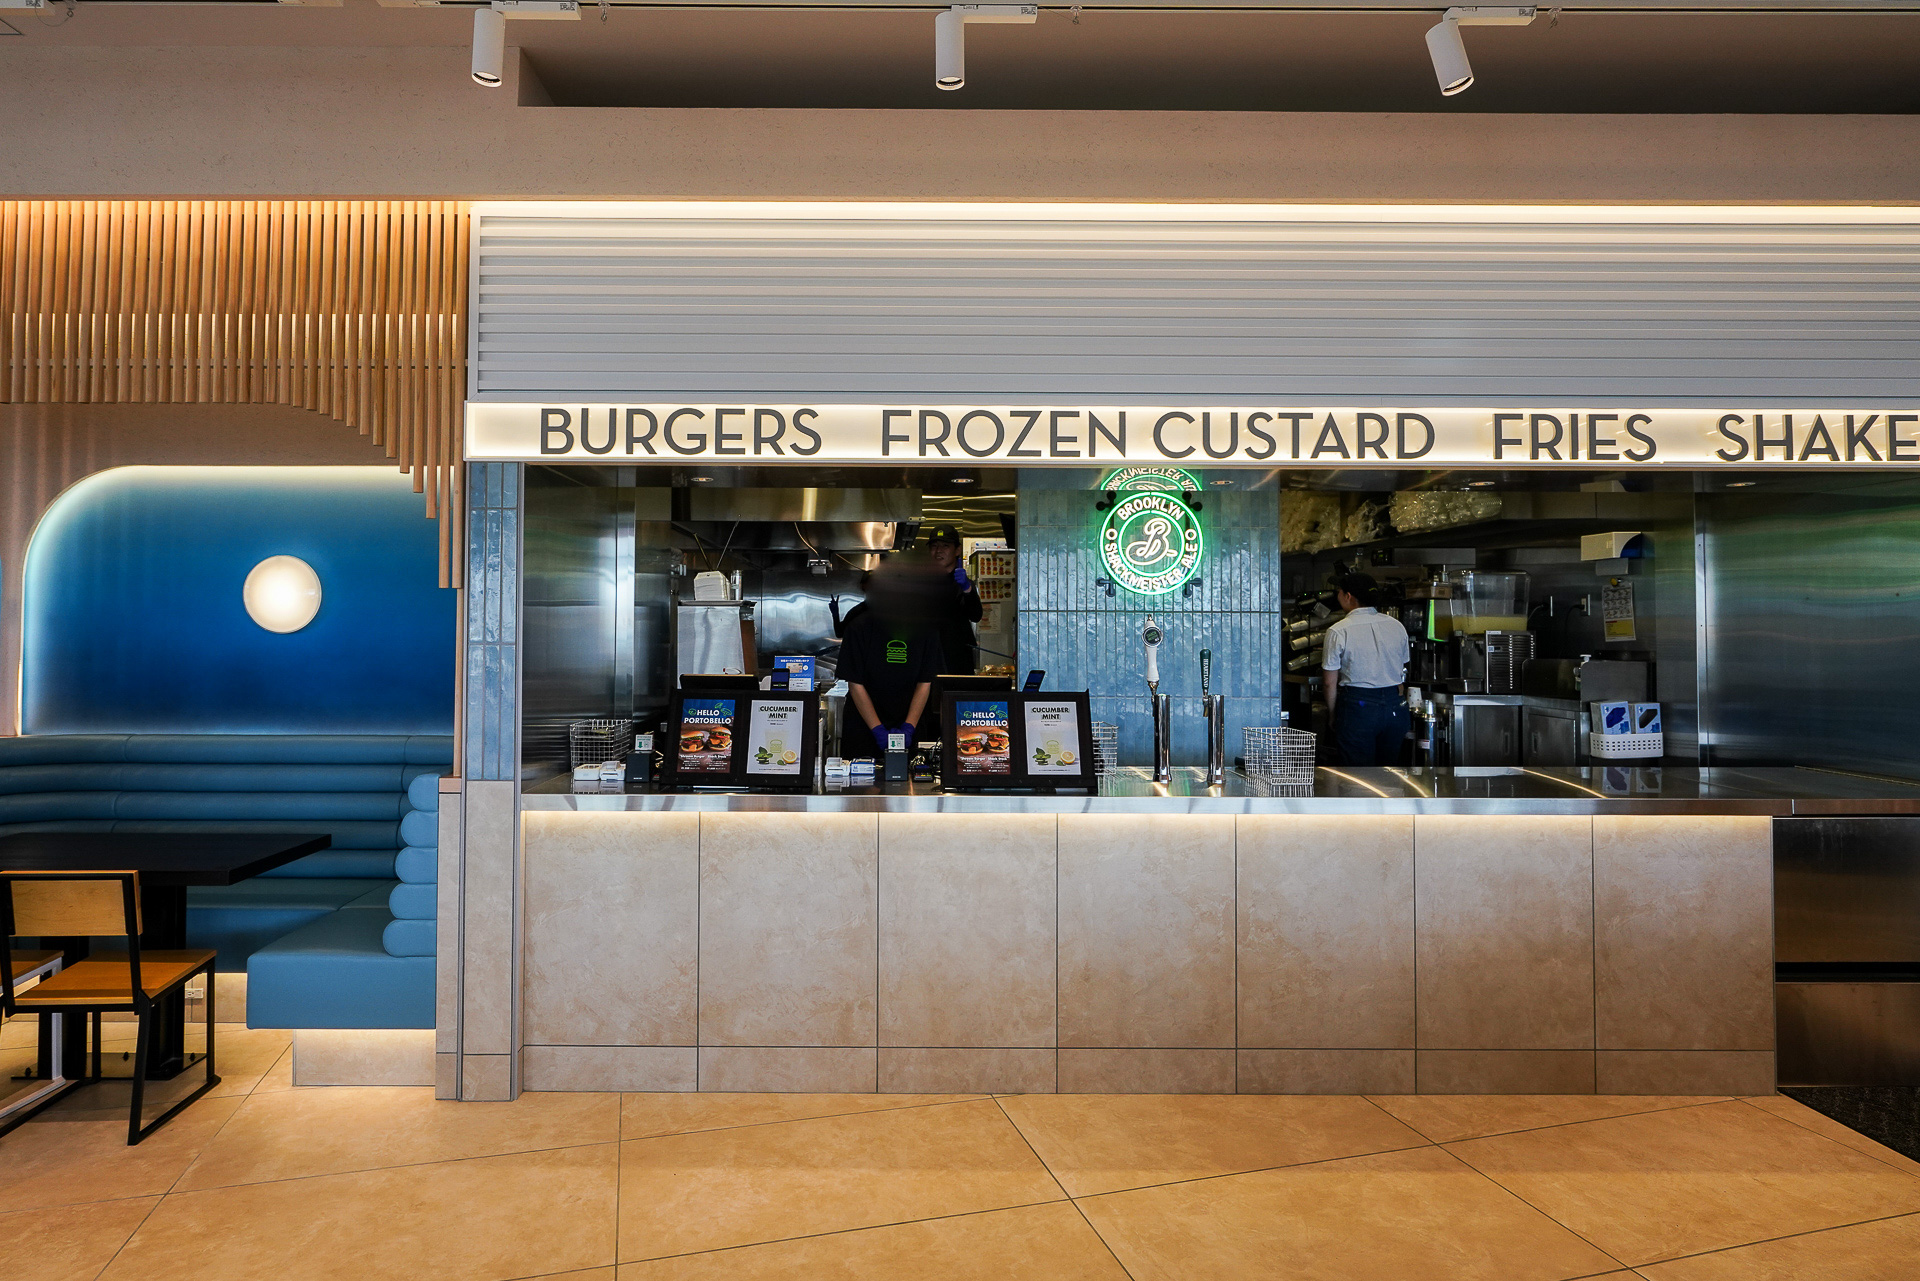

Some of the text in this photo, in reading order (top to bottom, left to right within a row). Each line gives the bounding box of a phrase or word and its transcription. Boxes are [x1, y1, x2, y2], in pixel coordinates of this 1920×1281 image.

[541, 408, 1920, 461] BURGERS FROZEN CUSTARD FRIES SHAKE
[1117, 496, 1185, 520] BROOKLYN
[1105, 542, 1198, 590] SHACKMEISTER ALE
[683, 717, 732, 725] PORTOBELLO
[960, 719, 1008, 727] PORTOBELLO
[972, 711, 996, 719] HELLO
